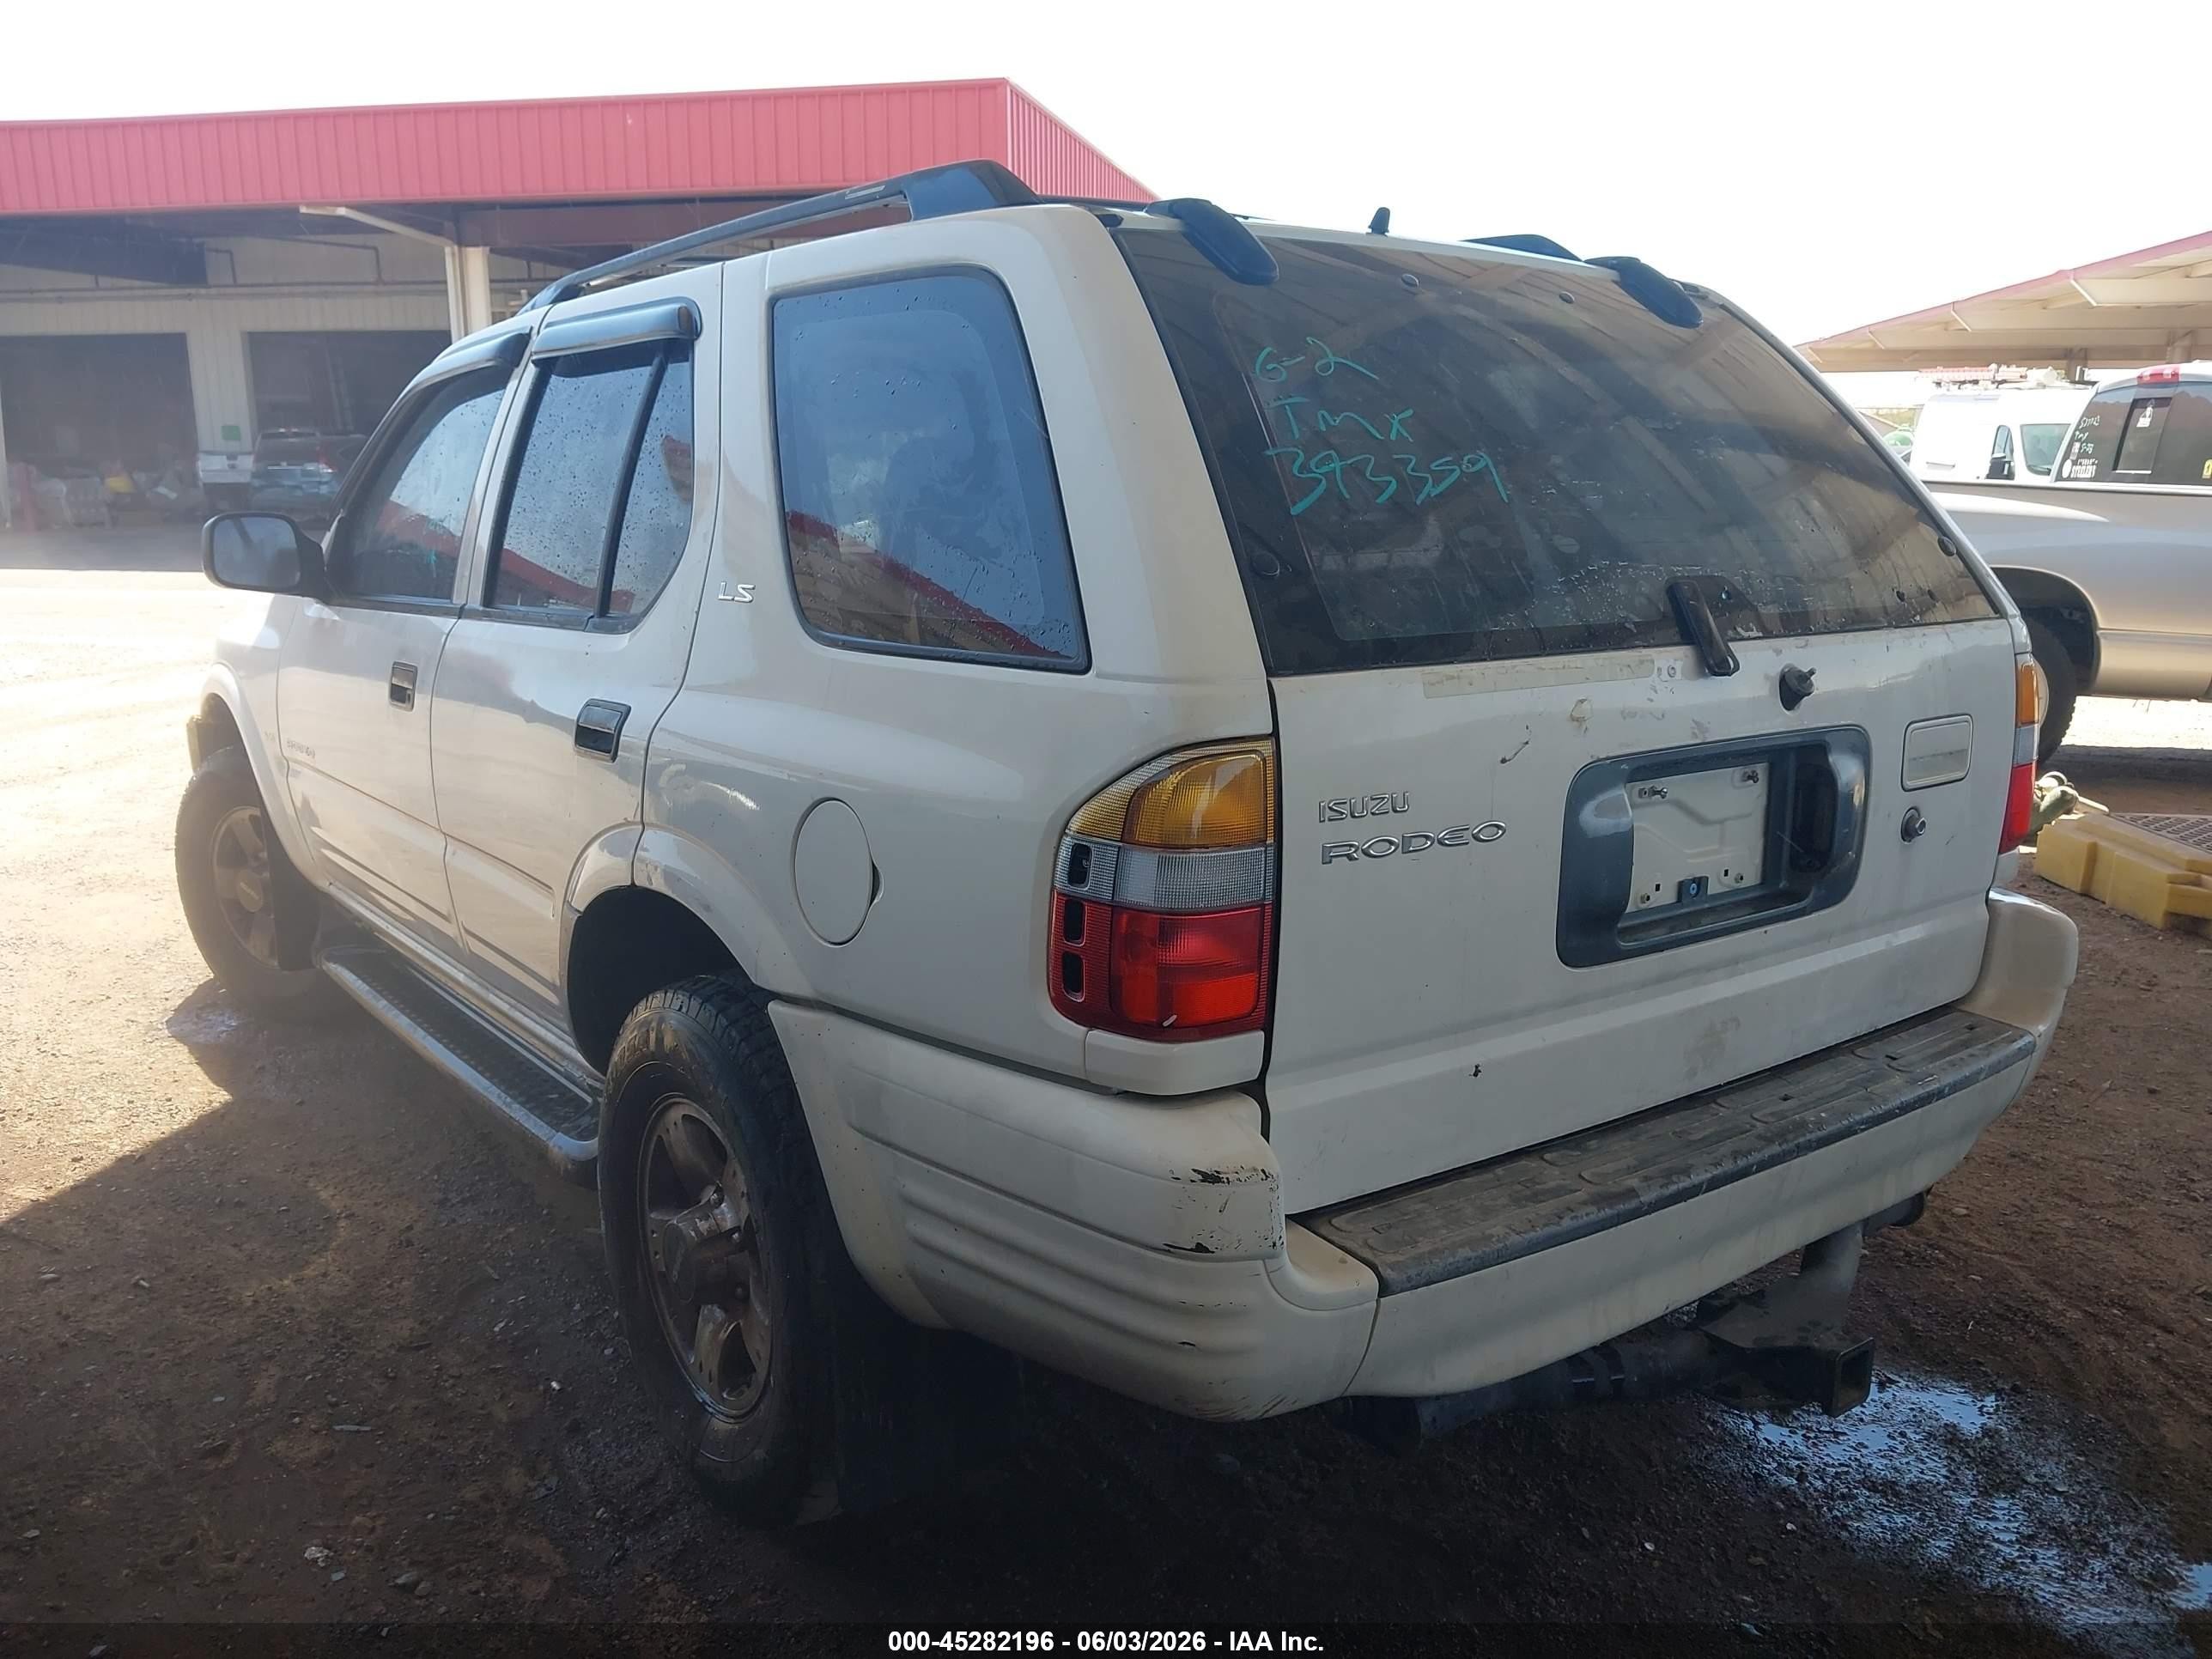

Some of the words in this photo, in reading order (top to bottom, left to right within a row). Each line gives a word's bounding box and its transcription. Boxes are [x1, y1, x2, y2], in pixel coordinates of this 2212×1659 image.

[718, 580, 756, 603] LS
[1318, 791, 1410, 823] ISUZU
[1321, 820, 1507, 865] RODEO
